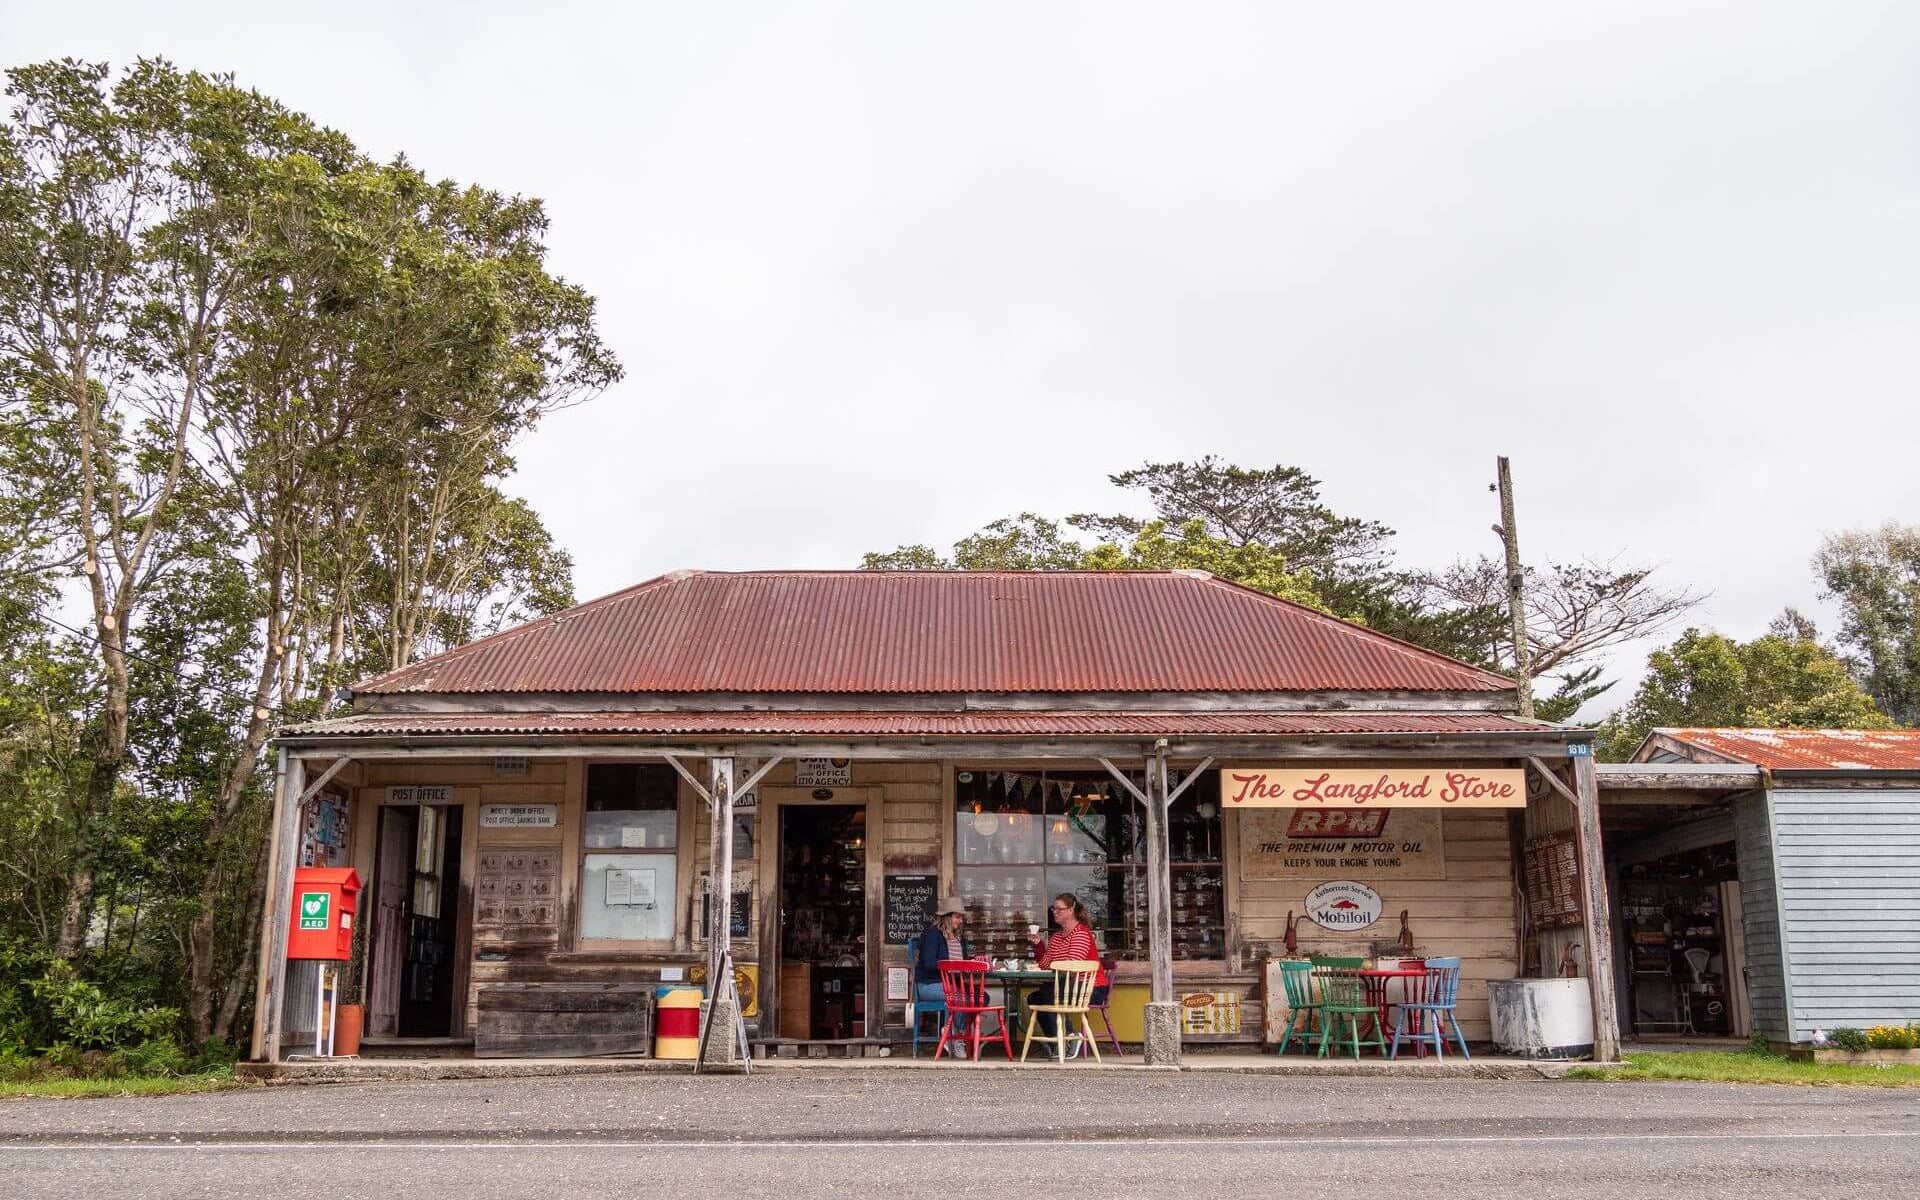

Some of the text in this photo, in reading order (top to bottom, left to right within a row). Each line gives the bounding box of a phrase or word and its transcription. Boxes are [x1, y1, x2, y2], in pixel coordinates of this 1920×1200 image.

[1568, 744, 1586, 754] 1810
[814, 777, 850, 785] AGENCY
[1232, 773, 1284, 802] The
[1293, 772, 1432, 804] Langford
[1440, 771, 1516, 802] Store
[392, 788, 446, 800] POST OFFICE
[509, 807, 526, 815] ORDER
[527, 807, 545, 815] OFFICE
[1295, 809, 1382, 833] RPM
[1260, 842, 1423, 853] THE PREMIUM MOTOR OIL
[1284, 858, 1402, 868] KEEPS YOUR ENGINE YOUNG
[1351, 885, 1373, 899] Service
[1317, 911, 1371, 924] Mobiloil
